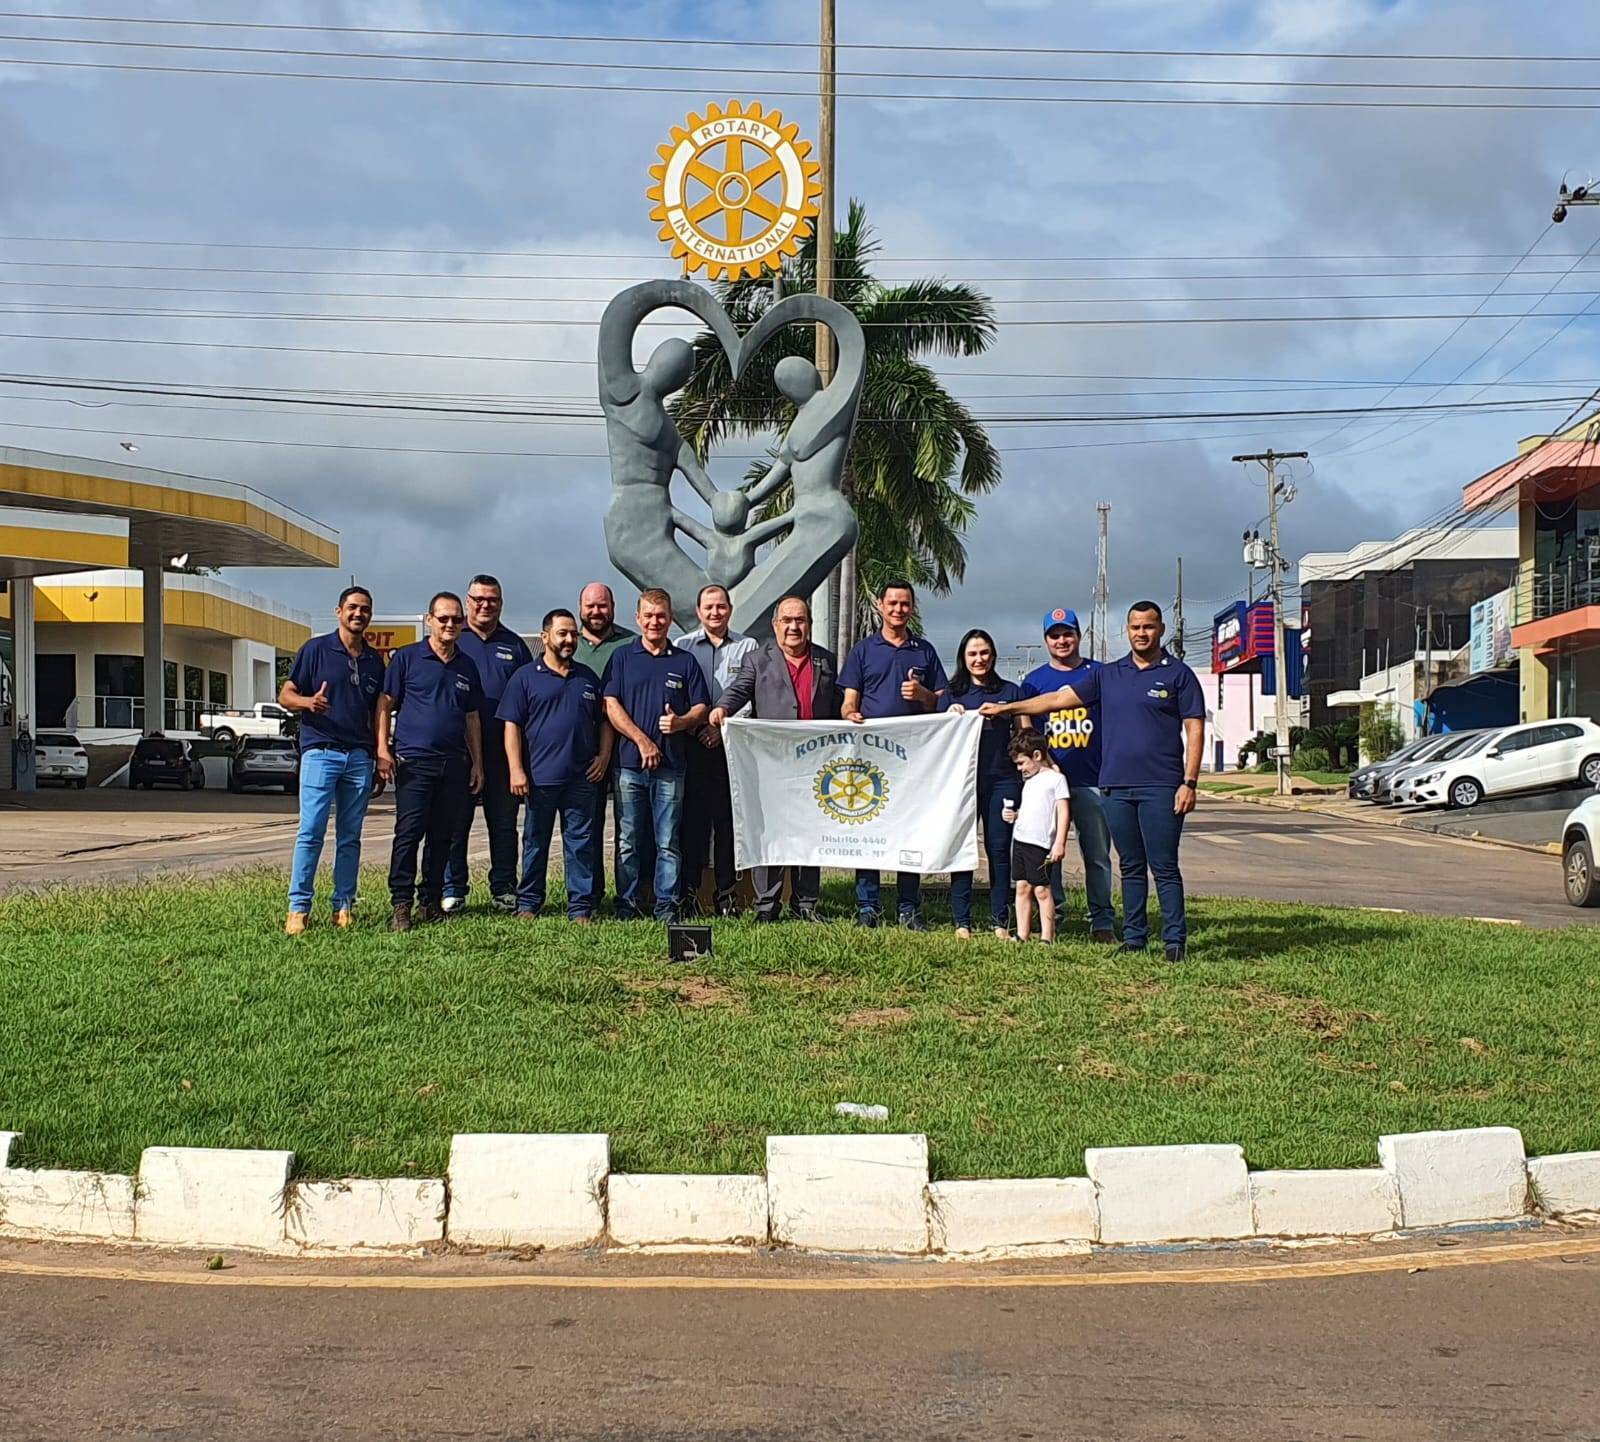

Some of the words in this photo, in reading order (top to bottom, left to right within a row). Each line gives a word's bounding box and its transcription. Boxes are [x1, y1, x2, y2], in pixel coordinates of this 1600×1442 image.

[701, 120, 773, 140] ROTARY
[673, 217, 793, 262] INTERNATIONAL
[365, 631, 395, 647] PIT
[1049, 707, 1087, 721] END
[1044, 719, 1094, 735] POLIO
[796, 732, 858, 759] ROTARY
[862, 733, 908, 761] CLUB
[1048, 733, 1091, 749] NOW
